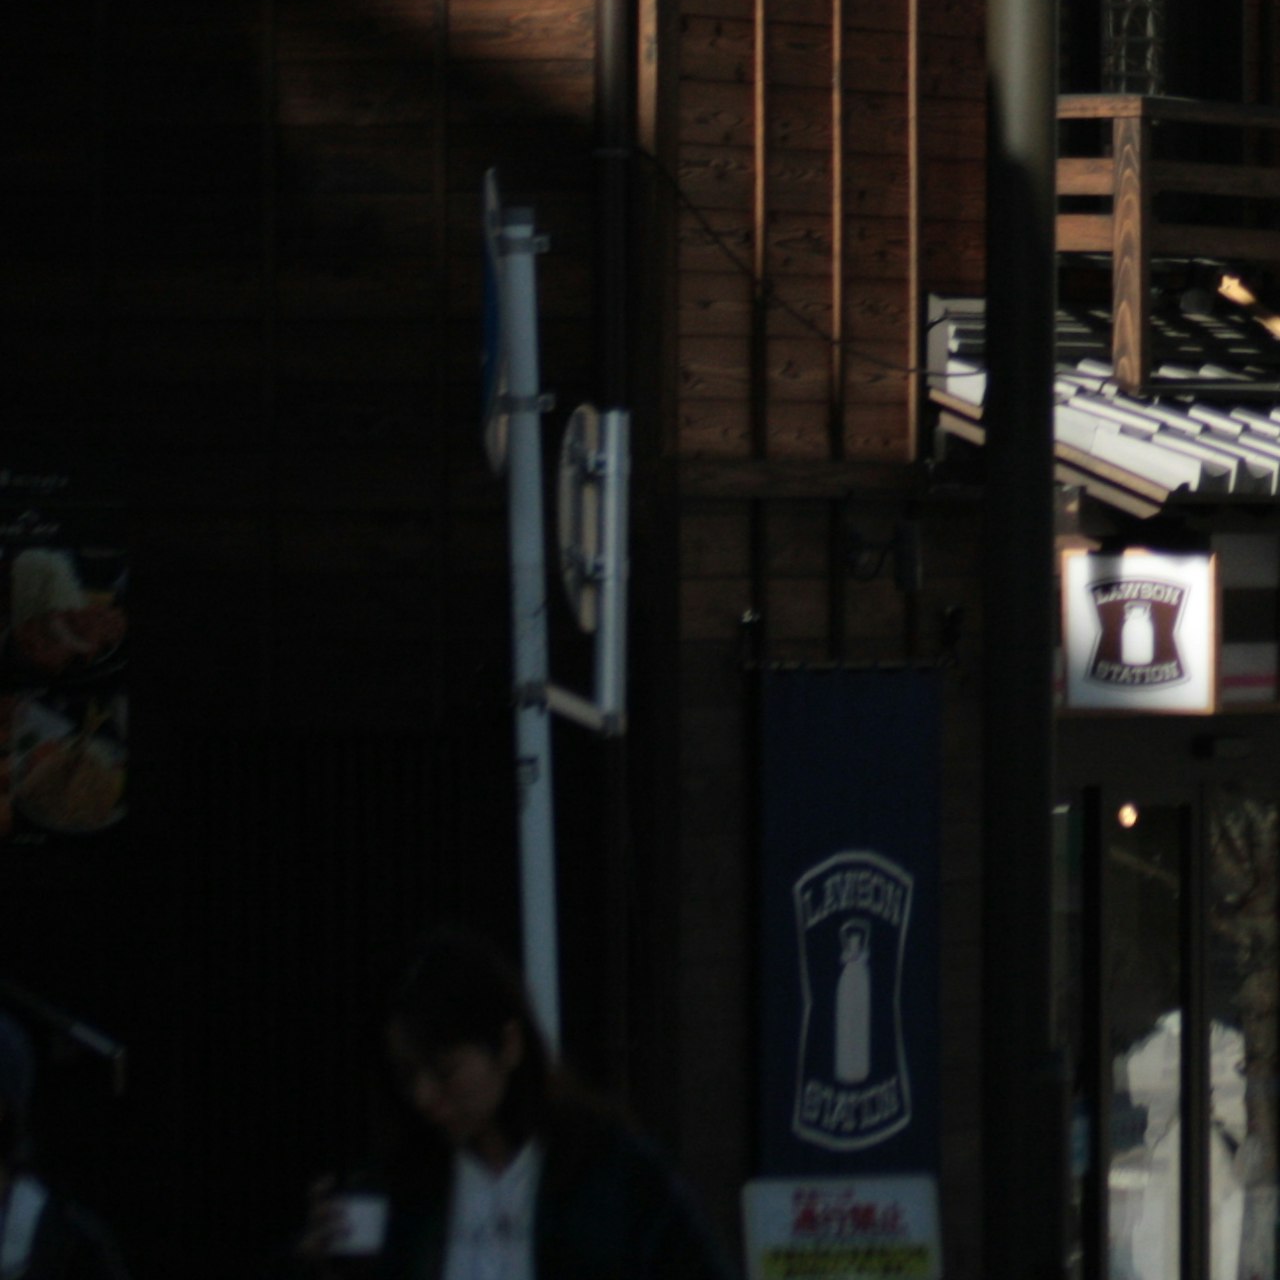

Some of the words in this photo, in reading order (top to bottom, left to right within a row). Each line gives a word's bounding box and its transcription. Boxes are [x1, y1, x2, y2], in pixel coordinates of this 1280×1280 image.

[1096, 580, 1182, 606] LAWSON
[1095, 660, 1181, 686] STATION
[801, 869, 903, 927] LAWSON
